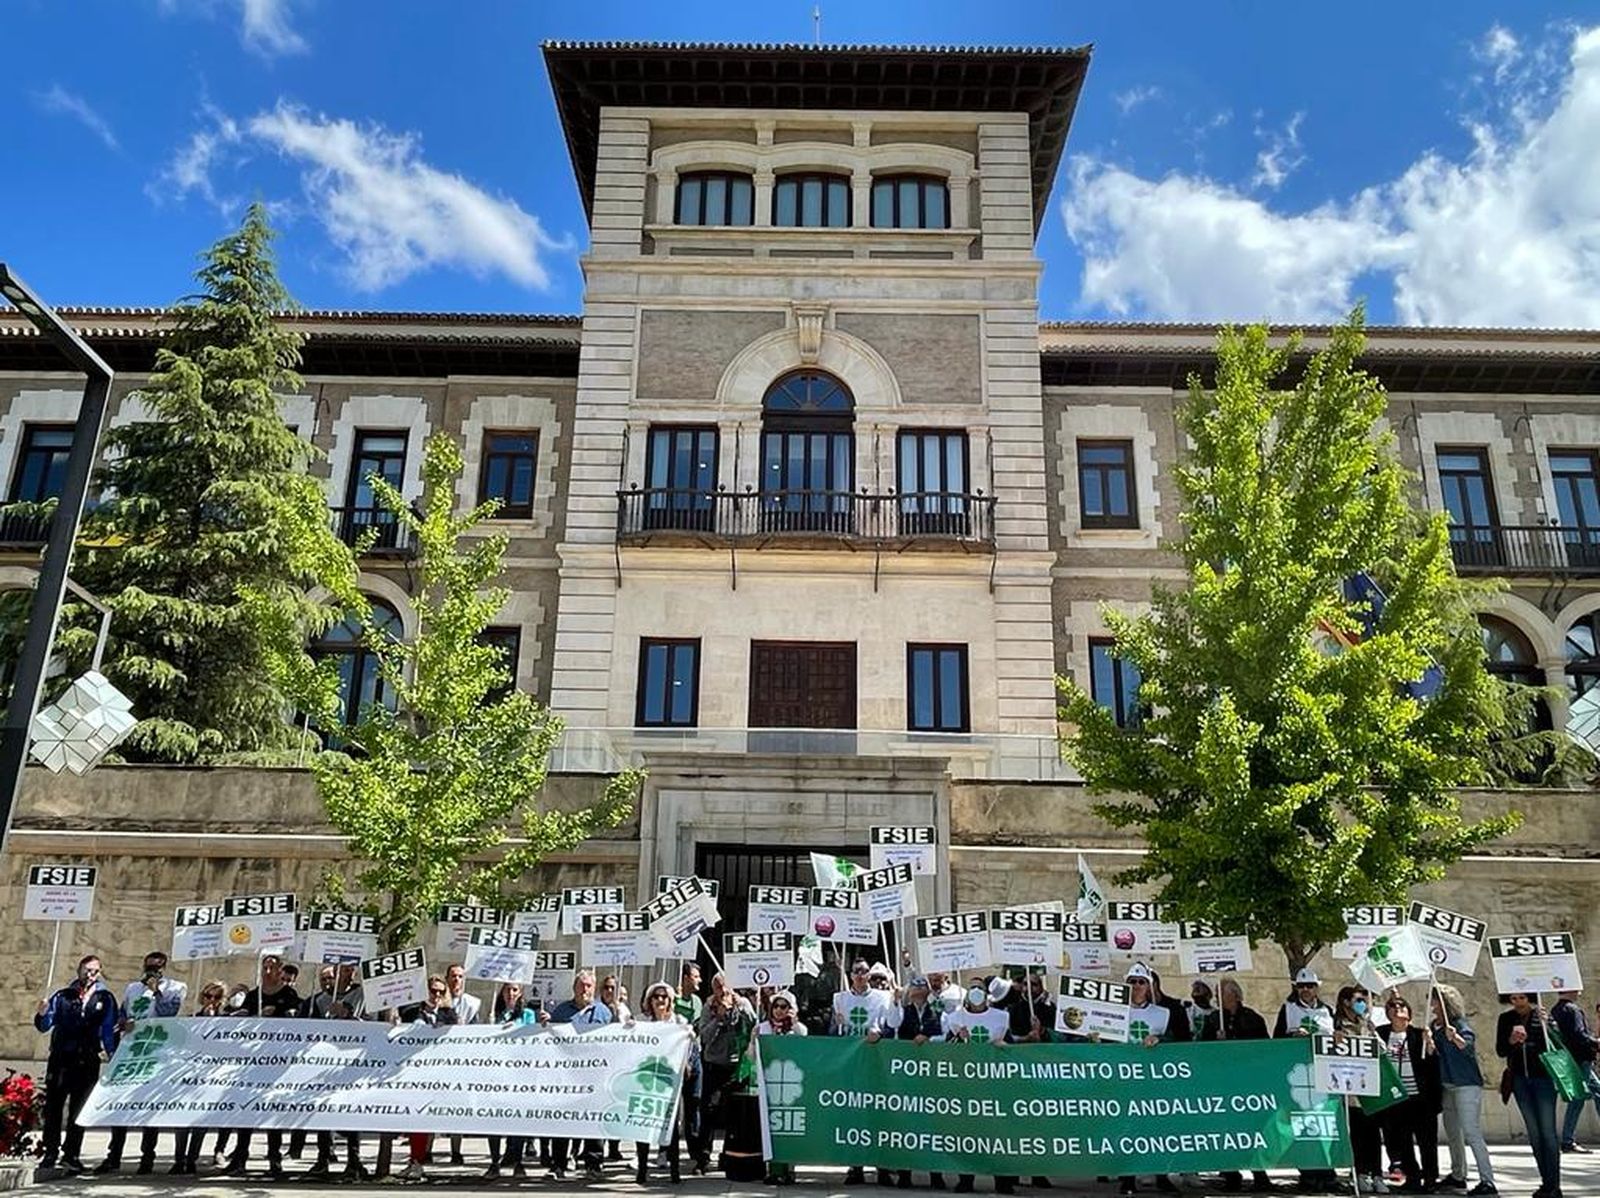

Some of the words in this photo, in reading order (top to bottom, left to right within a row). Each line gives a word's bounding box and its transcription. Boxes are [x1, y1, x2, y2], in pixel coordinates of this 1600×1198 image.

[878, 828, 929, 844] FSIE
[36, 868, 91, 886] FSIE
[862, 866, 908, 891] FSIE
[571, 888, 617, 904] FSIE
[666, 879, 712, 895] FE
[521, 897, 558, 912] FSIE
[648, 881, 698, 920] FSIE
[757, 888, 804, 905] FSIE
[820, 890, 857, 909] FSI
[232, 896, 288, 916] FSIE
[447, 906, 497, 924] FSIE
[319, 913, 375, 933] FSIE
[590, 914, 644, 932] FSIE
[925, 913, 981, 936] FSIE
[999, 912, 1056, 930] FSIE
[1342, 907, 1397, 925] FSIE
[1417, 906, 1479, 939] FSIE
[478, 928, 533, 950] FSIE
[1064, 924, 1101, 941] SIE
[732, 934, 787, 952] FSIE
[1499, 936, 1566, 956] FSIE
[368, 951, 419, 977] FSIE
[535, 952, 570, 970] SIE
[1068, 979, 1124, 1003] FSIE
[213, 1032, 257, 1040] ABONO
[259, 1033, 302, 1042] DEUDA
[305, 1034, 367, 1043] SALARIAL
[399, 1036, 491, 1045] COMPLEMENTO
[493, 1036, 516, 1045] PAS
[519, 1036, 527, 1045] Y
[544, 1035, 660, 1045] COMPLEMENTARIO
[1321, 1036, 1373, 1057] FSIE
[112, 1061, 157, 1079] FSIE
[194, 1055, 288, 1066] CONCERTACIÓN
[290, 1057, 386, 1068] BACHILLERATO
[406, 1057, 503, 1067] EQUIPARACIÓN
[505, 1059, 534, 1068] CON
[535, 1060, 551, 1068] LA
[554, 1056, 609, 1068] PÚBLICA
[890, 1059, 931, 1077] POR
[937, 1061, 959, 1078] EL
[964, 1062, 1113, 1080] CUMPLIMIENTO
[1118, 1063, 1145, 1080] DE
[1150, 1061, 1192, 1079] LOS
[255, 1081, 274, 1090] DE
[276, 1081, 364, 1091] ORIENTACIÓN
[376, 1079, 451, 1090] EXTENSIÓN
[452, 1082, 463, 1091] A
[466, 1083, 509, 1092] TODOS
[513, 1084, 536, 1093] LOS
[539, 1084, 595, 1094] NIVELES
[106, 1101, 185, 1111] ADECUACIÓN
[187, 1102, 236, 1111] RATIOS
[251, 1102, 316, 1112] AUMENTO
[317, 1103, 337, 1113] DE
[338, 1104, 411, 1115] PLANTILLA
[628, 1096, 674, 1119] FSIE
[818, 1089, 962, 1115] COMPROMISOS
[967, 1100, 1007, 1117] DEL
[1012, 1099, 1121, 1117] GOBIERNO
[1127, 1096, 1226, 1117] ANDALUZ
[1231, 1093, 1278, 1111] CON
[427, 1106, 473, 1117] MENOR
[476, 1107, 522, 1118] CARGA
[525, 1108, 622, 1123] BUROCRÁTICA
[768, 1111, 806, 1131] SIE
[1290, 1115, 1339, 1137] FSIE
[835, 1127, 872, 1146] LOS
[878, 1131, 1046, 1156] PROFESIONALES
[1052, 1137, 1082, 1155] DE
[1087, 1137, 1115, 1154] LA
[1119, 1132, 1268, 1155] CONCERTADA
